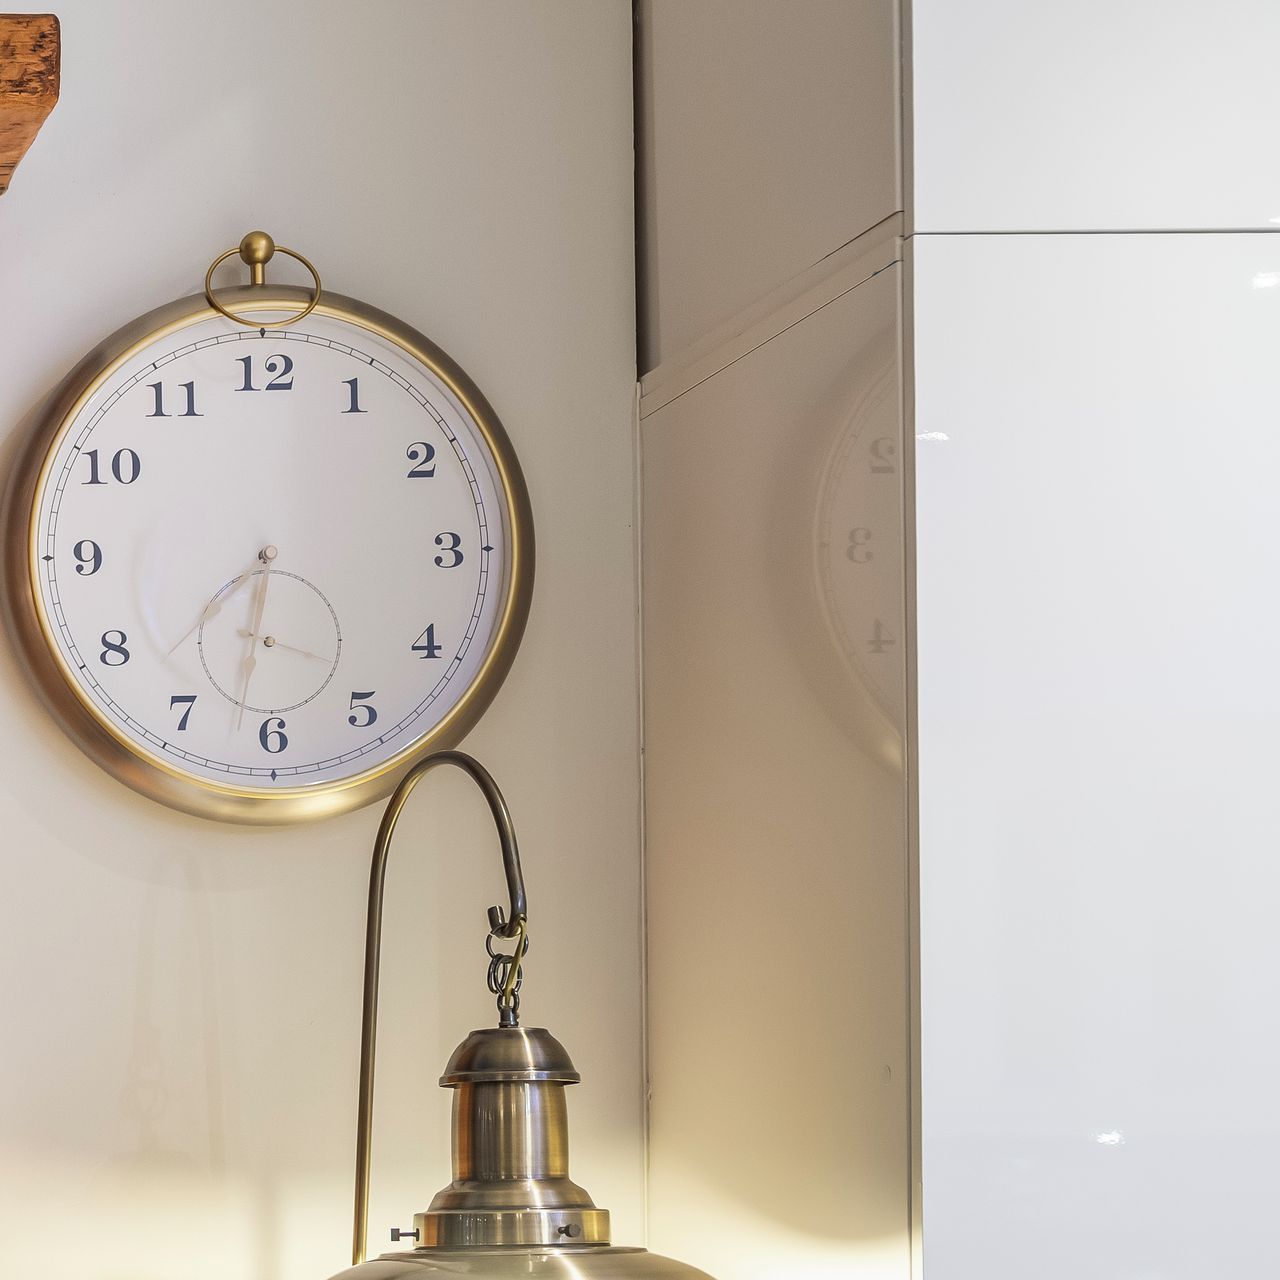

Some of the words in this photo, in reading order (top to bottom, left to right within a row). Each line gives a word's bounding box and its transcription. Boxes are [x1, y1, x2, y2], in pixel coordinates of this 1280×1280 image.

[234, 353, 294, 392] 12
[145, 380, 205, 418] 11
[340, 377, 369, 414] 1
[81, 447, 142, 485] 10
[405, 441, 437, 479] 2
[73, 539, 103, 577] 9
[433, 531, 465, 569] 3
[99, 629, 131, 667] 8
[410, 622, 443, 660] 4
[169, 695, 198, 732] 7
[347, 690, 378, 728] 5
[258, 716, 289, 754] 6
